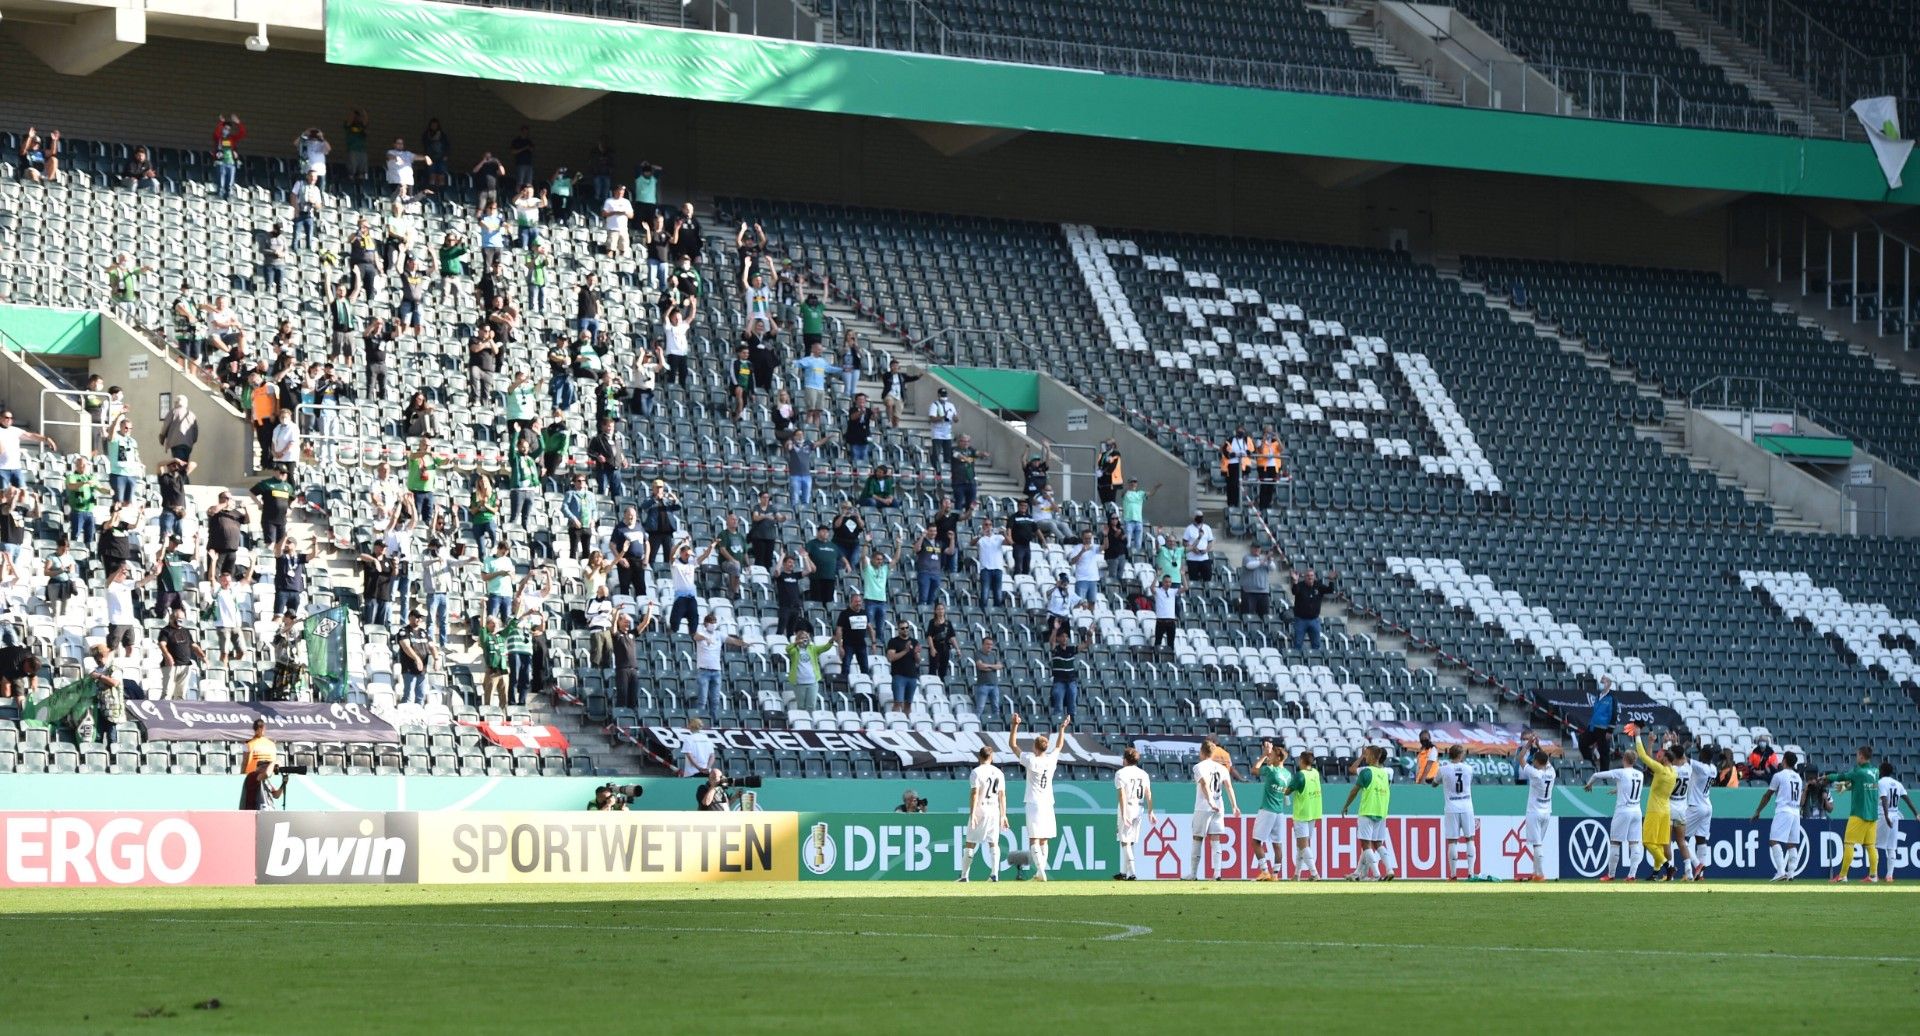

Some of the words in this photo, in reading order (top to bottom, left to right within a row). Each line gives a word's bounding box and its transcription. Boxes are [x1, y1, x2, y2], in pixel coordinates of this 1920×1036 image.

[1628, 711, 1655, 724] 2005
[1040, 769, 1048, 789] 6
[1454, 773, 1464, 794] 3
[1543, 780, 1551, 799] 7
[1629, 779, 1642, 800] 17
[1671, 778, 1690, 797] 25
[1790, 780, 1800, 802] 13
[1888, 787, 1900, 809] 16
[6, 817, 202, 884] ERGO
[264, 817, 407, 878] bwin
[452, 823, 773, 873] SPORTWETTEN
